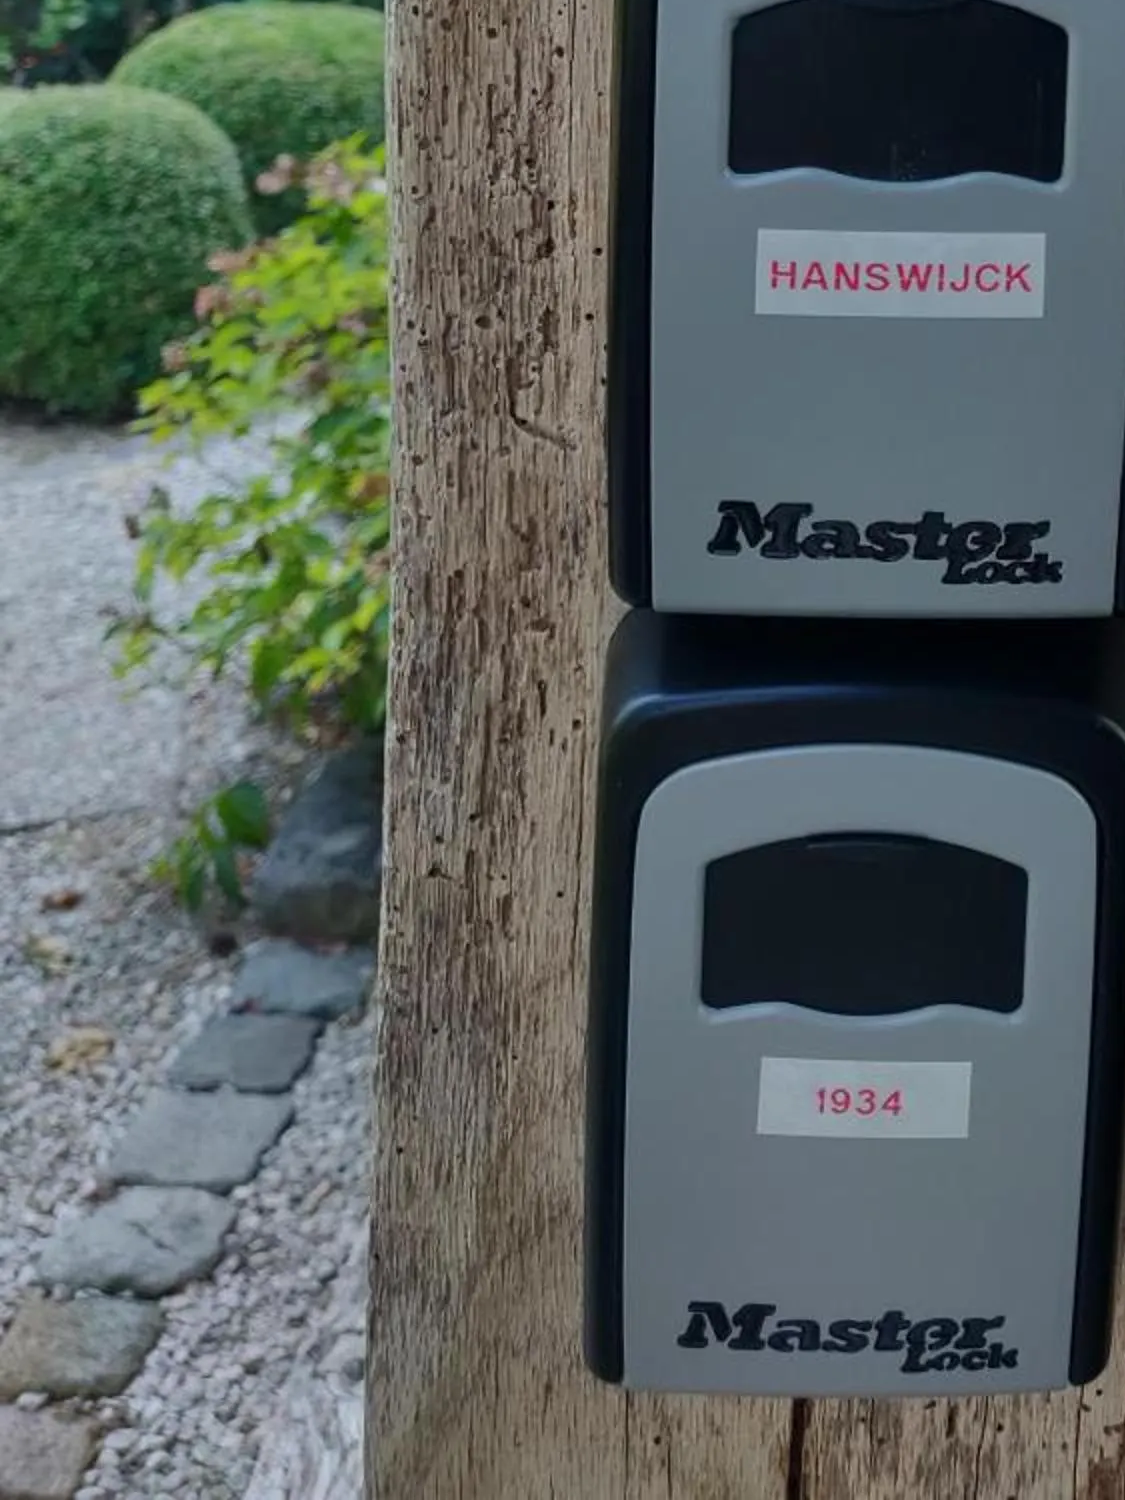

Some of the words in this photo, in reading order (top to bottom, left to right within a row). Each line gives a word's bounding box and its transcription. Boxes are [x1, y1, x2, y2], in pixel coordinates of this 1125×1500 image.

[768, 260, 1032, 293] HANSWIJCK
[707, 500, 1051, 562] Master
[941, 553, 1063, 585] Lock
[815, 1088, 903, 1116] 1934
[676, 1301, 1006, 1353] Master
[900, 1342, 1019, 1374] Lock
